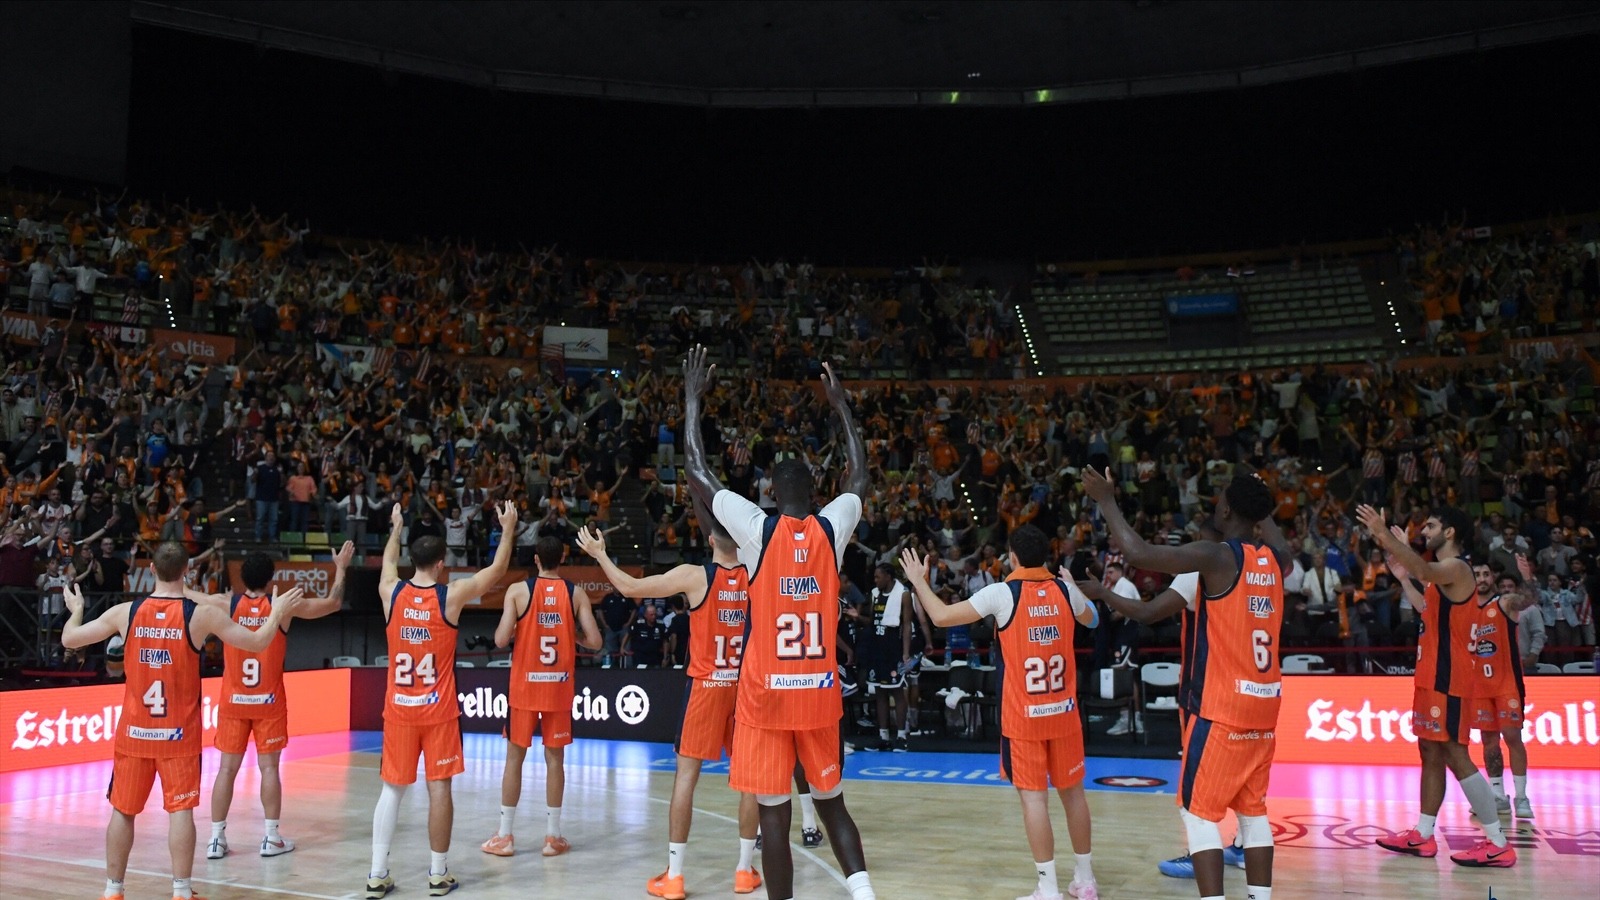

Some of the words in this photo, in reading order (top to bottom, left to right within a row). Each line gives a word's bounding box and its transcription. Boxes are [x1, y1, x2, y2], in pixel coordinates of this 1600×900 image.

[2, 316, 40, 340] YMA
[794, 549, 808, 562] ILY
[780, 576, 821, 595] LEYMA
[544, 597, 556, 605] JOU
[718, 590, 748, 601] BRNOIC
[403, 608, 430, 620] CREMO
[1028, 605, 1059, 618] VARELA
[134, 626, 183, 640] JORGENSEN
[401, 626, 432, 641] LEYMA
[776, 612, 826, 660] 21
[1028, 625, 1061, 642] LEYMA
[139, 648, 173, 665] LEYMA
[540, 636, 558, 666] 5
[714, 635, 743, 668] 13
[1251, 629, 1272, 673] 6
[242, 658, 261, 688] 9
[394, 652, 438, 686] 24
[531, 673, 557, 681] Aluman
[1024, 654, 1066, 694] 22
[1483, 664, 1493, 678] 0
[775, 677, 814, 687] Aluman
[143, 680, 167, 717] 4
[1032, 705, 1062, 716] Aluman
[11, 705, 123, 750] Estrell
[132, 729, 165, 739] Aluman
